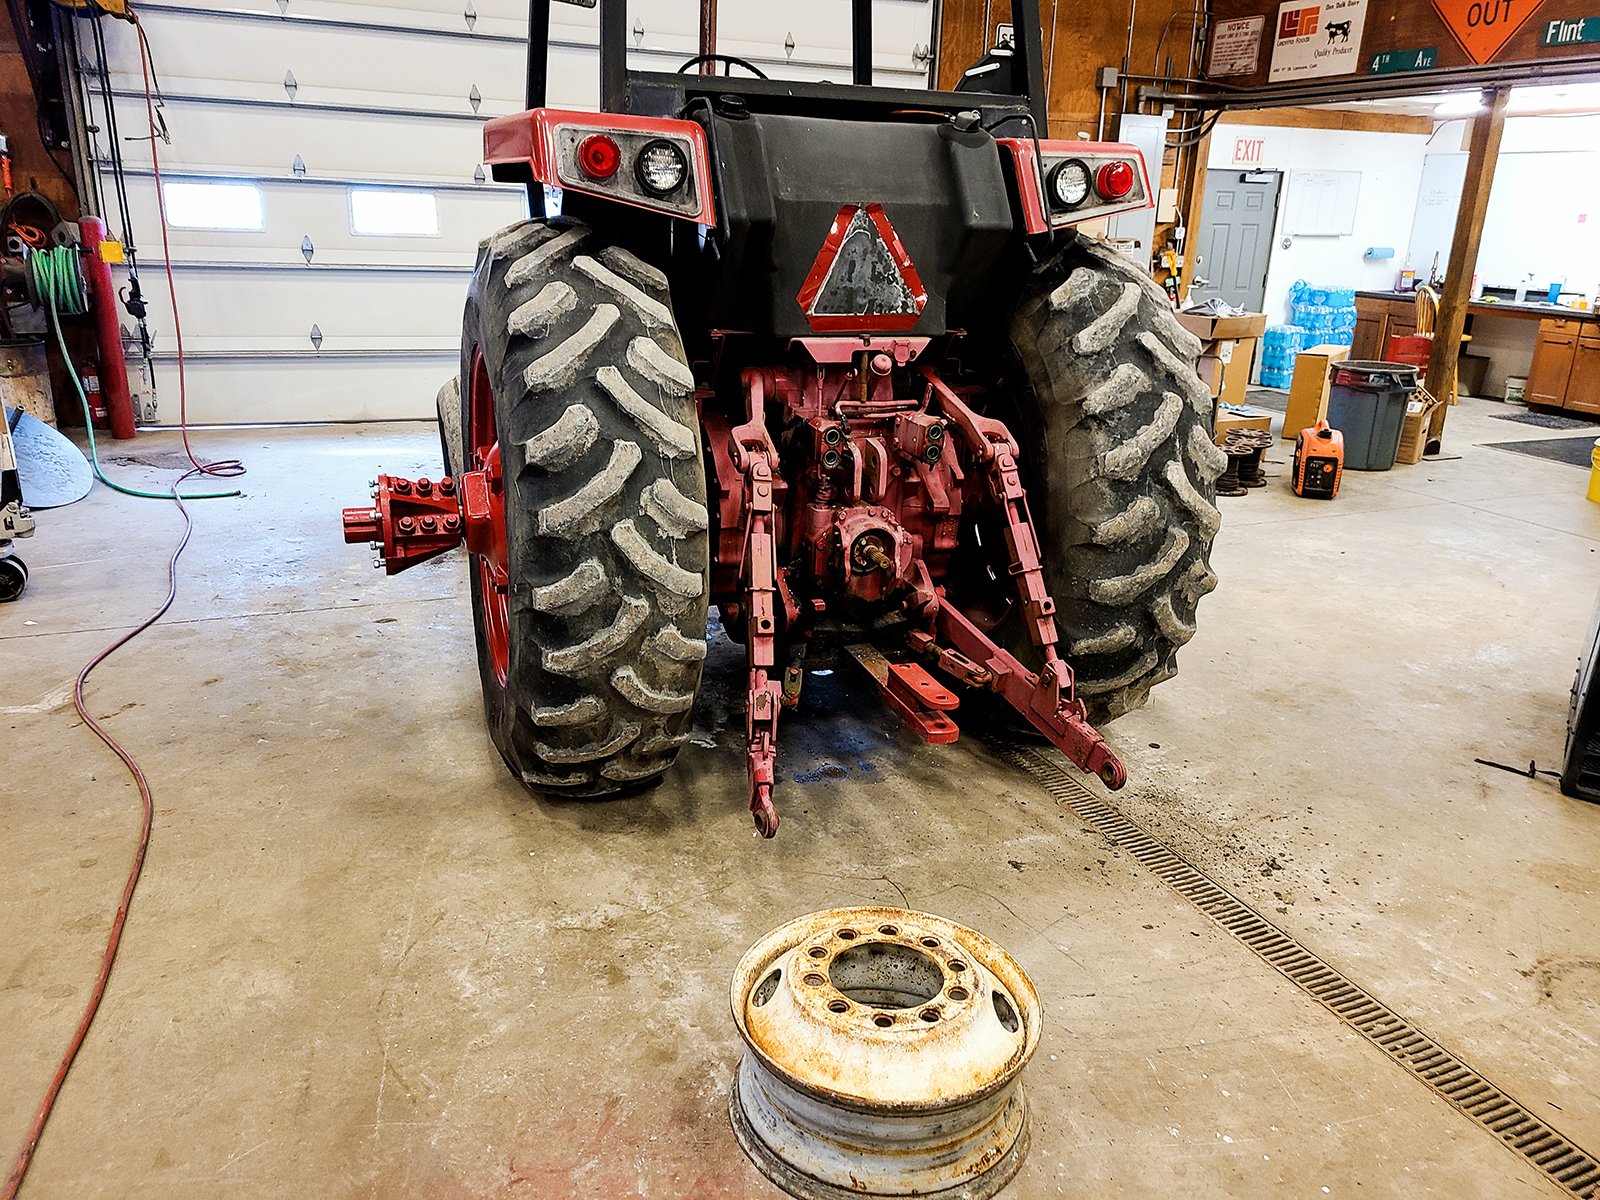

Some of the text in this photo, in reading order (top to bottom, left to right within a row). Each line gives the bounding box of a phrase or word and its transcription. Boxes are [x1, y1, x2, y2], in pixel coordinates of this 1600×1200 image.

[1467, 0, 1513, 27] OUT
[1546, 18, 1585, 44] Flint
[1314, 49, 1331, 58] Quality
[1235, 139, 1264, 162] EXIT
